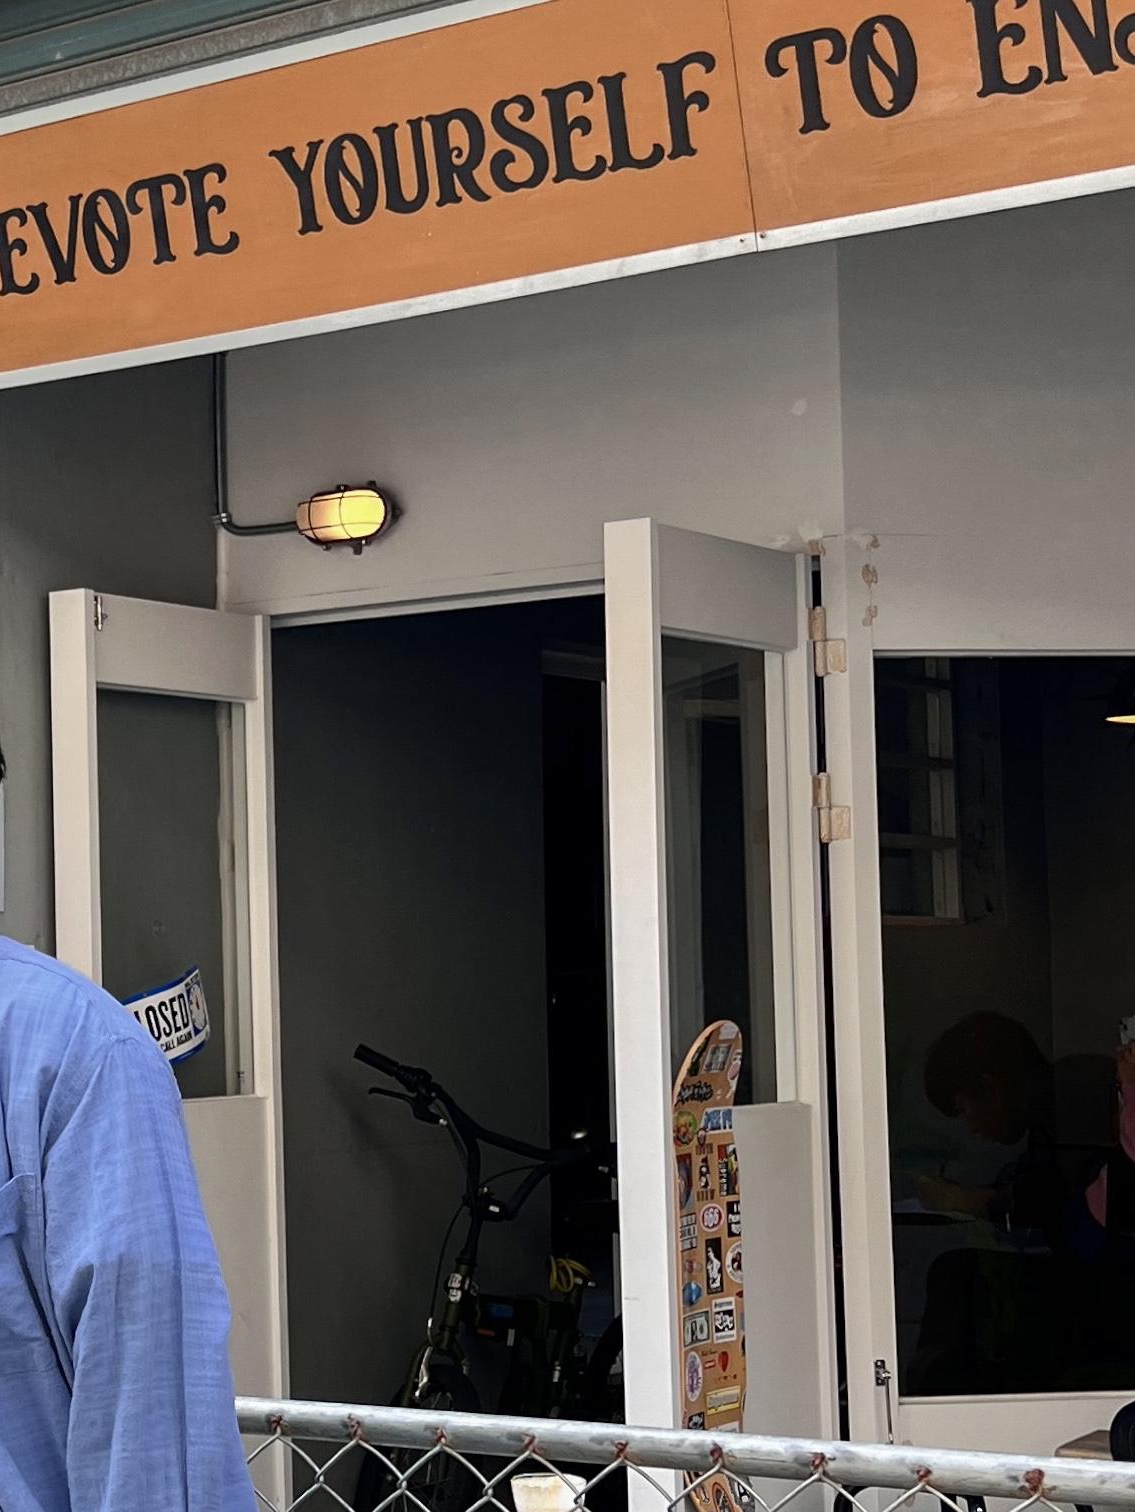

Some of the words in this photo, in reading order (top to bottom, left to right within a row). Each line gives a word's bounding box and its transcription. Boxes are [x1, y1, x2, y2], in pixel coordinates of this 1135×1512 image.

[269, 51, 717, 235] YOURSELF
[765, 14, 919, 135] TO
[133, 992, 190, 1042] OSED
